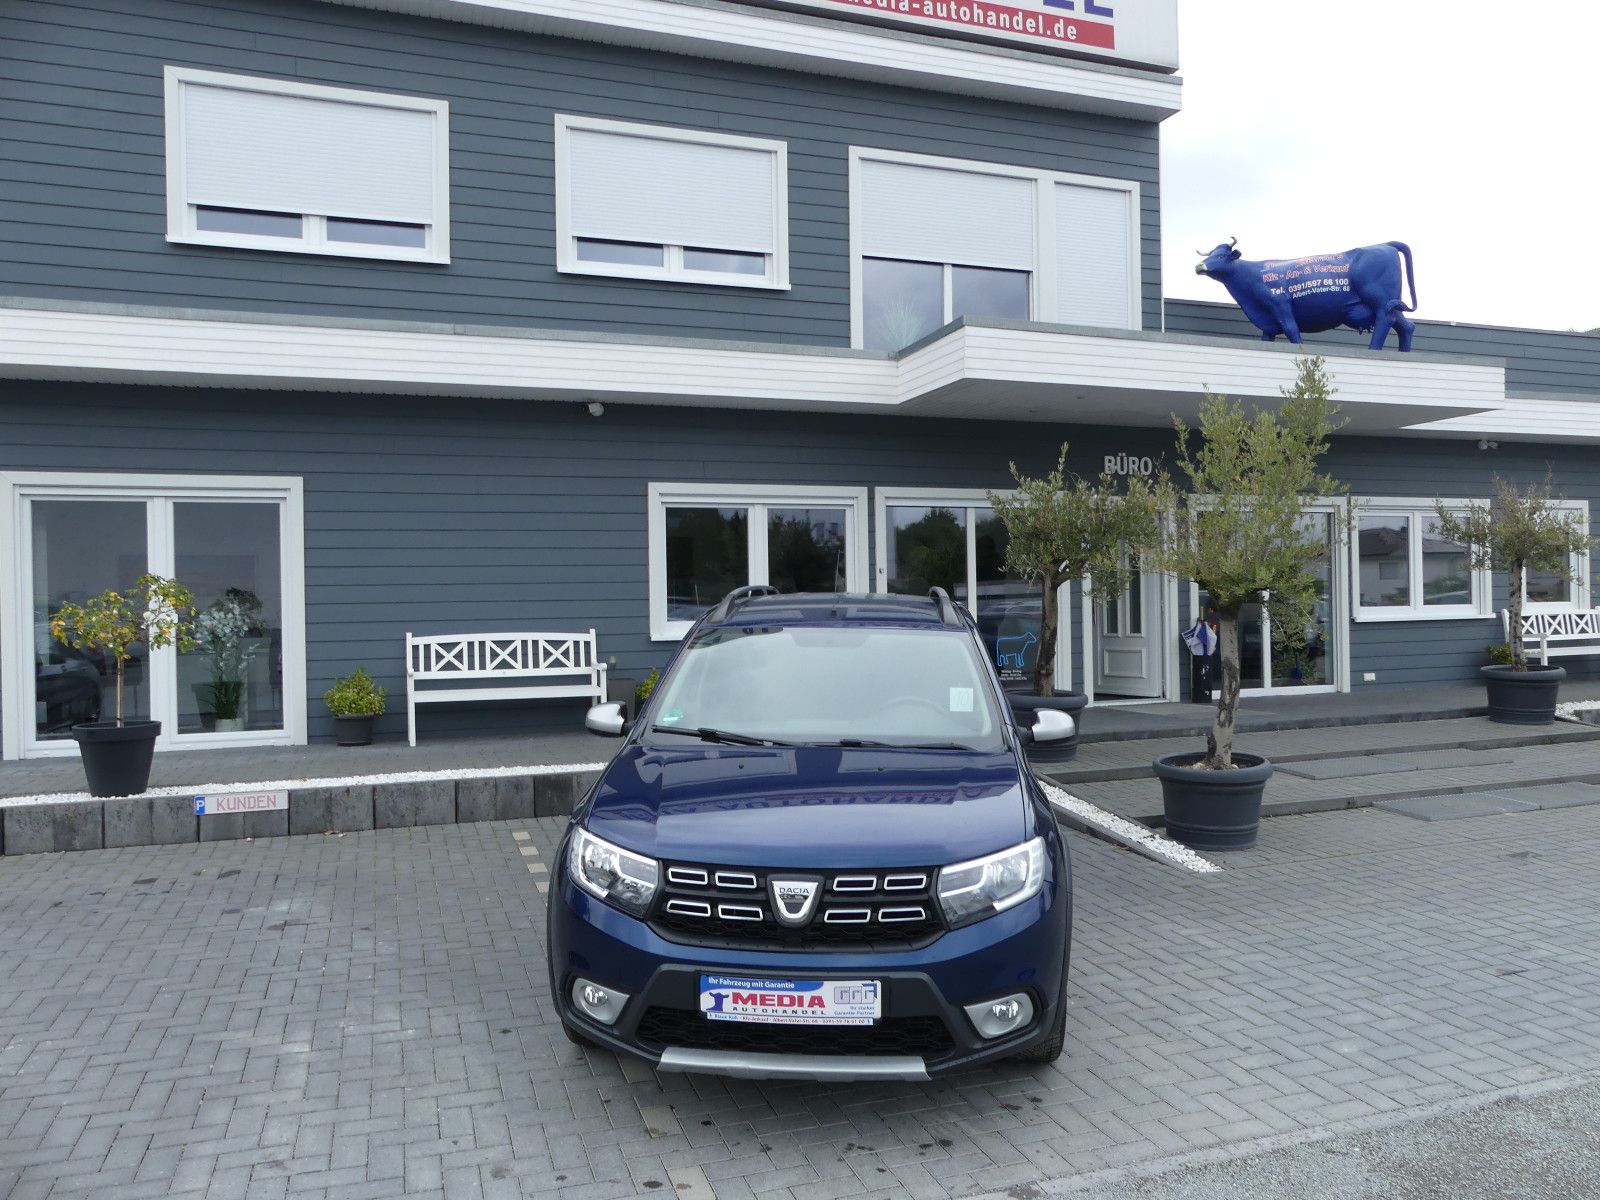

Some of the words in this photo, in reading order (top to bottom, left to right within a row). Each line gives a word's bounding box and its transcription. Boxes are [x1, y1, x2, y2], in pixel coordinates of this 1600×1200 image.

[848, 0, 1078, 40] a-autohandel.de
[1270, 287, 1286, 295] Tel.
[1288, 279, 1322, 293] 0391/597
[1335, 278, 1349, 286] 100
[1292, 285, 1342, 299] Albert-Vater-Str.
[1104, 452, 1153, 476] BÜRO
[196, 799, 205, 811] P
[216, 794, 277, 811] KUNDEN
[708, 977, 719, 985] Ihr
[719, 978, 751, 988] Fahrzeug
[752, 980, 764, 988] mit
[764, 981, 795, 989] Garantie
[731, 991, 826, 1009] MEDIA
[731, 1006, 826, 1015] AUTOHANDEL
